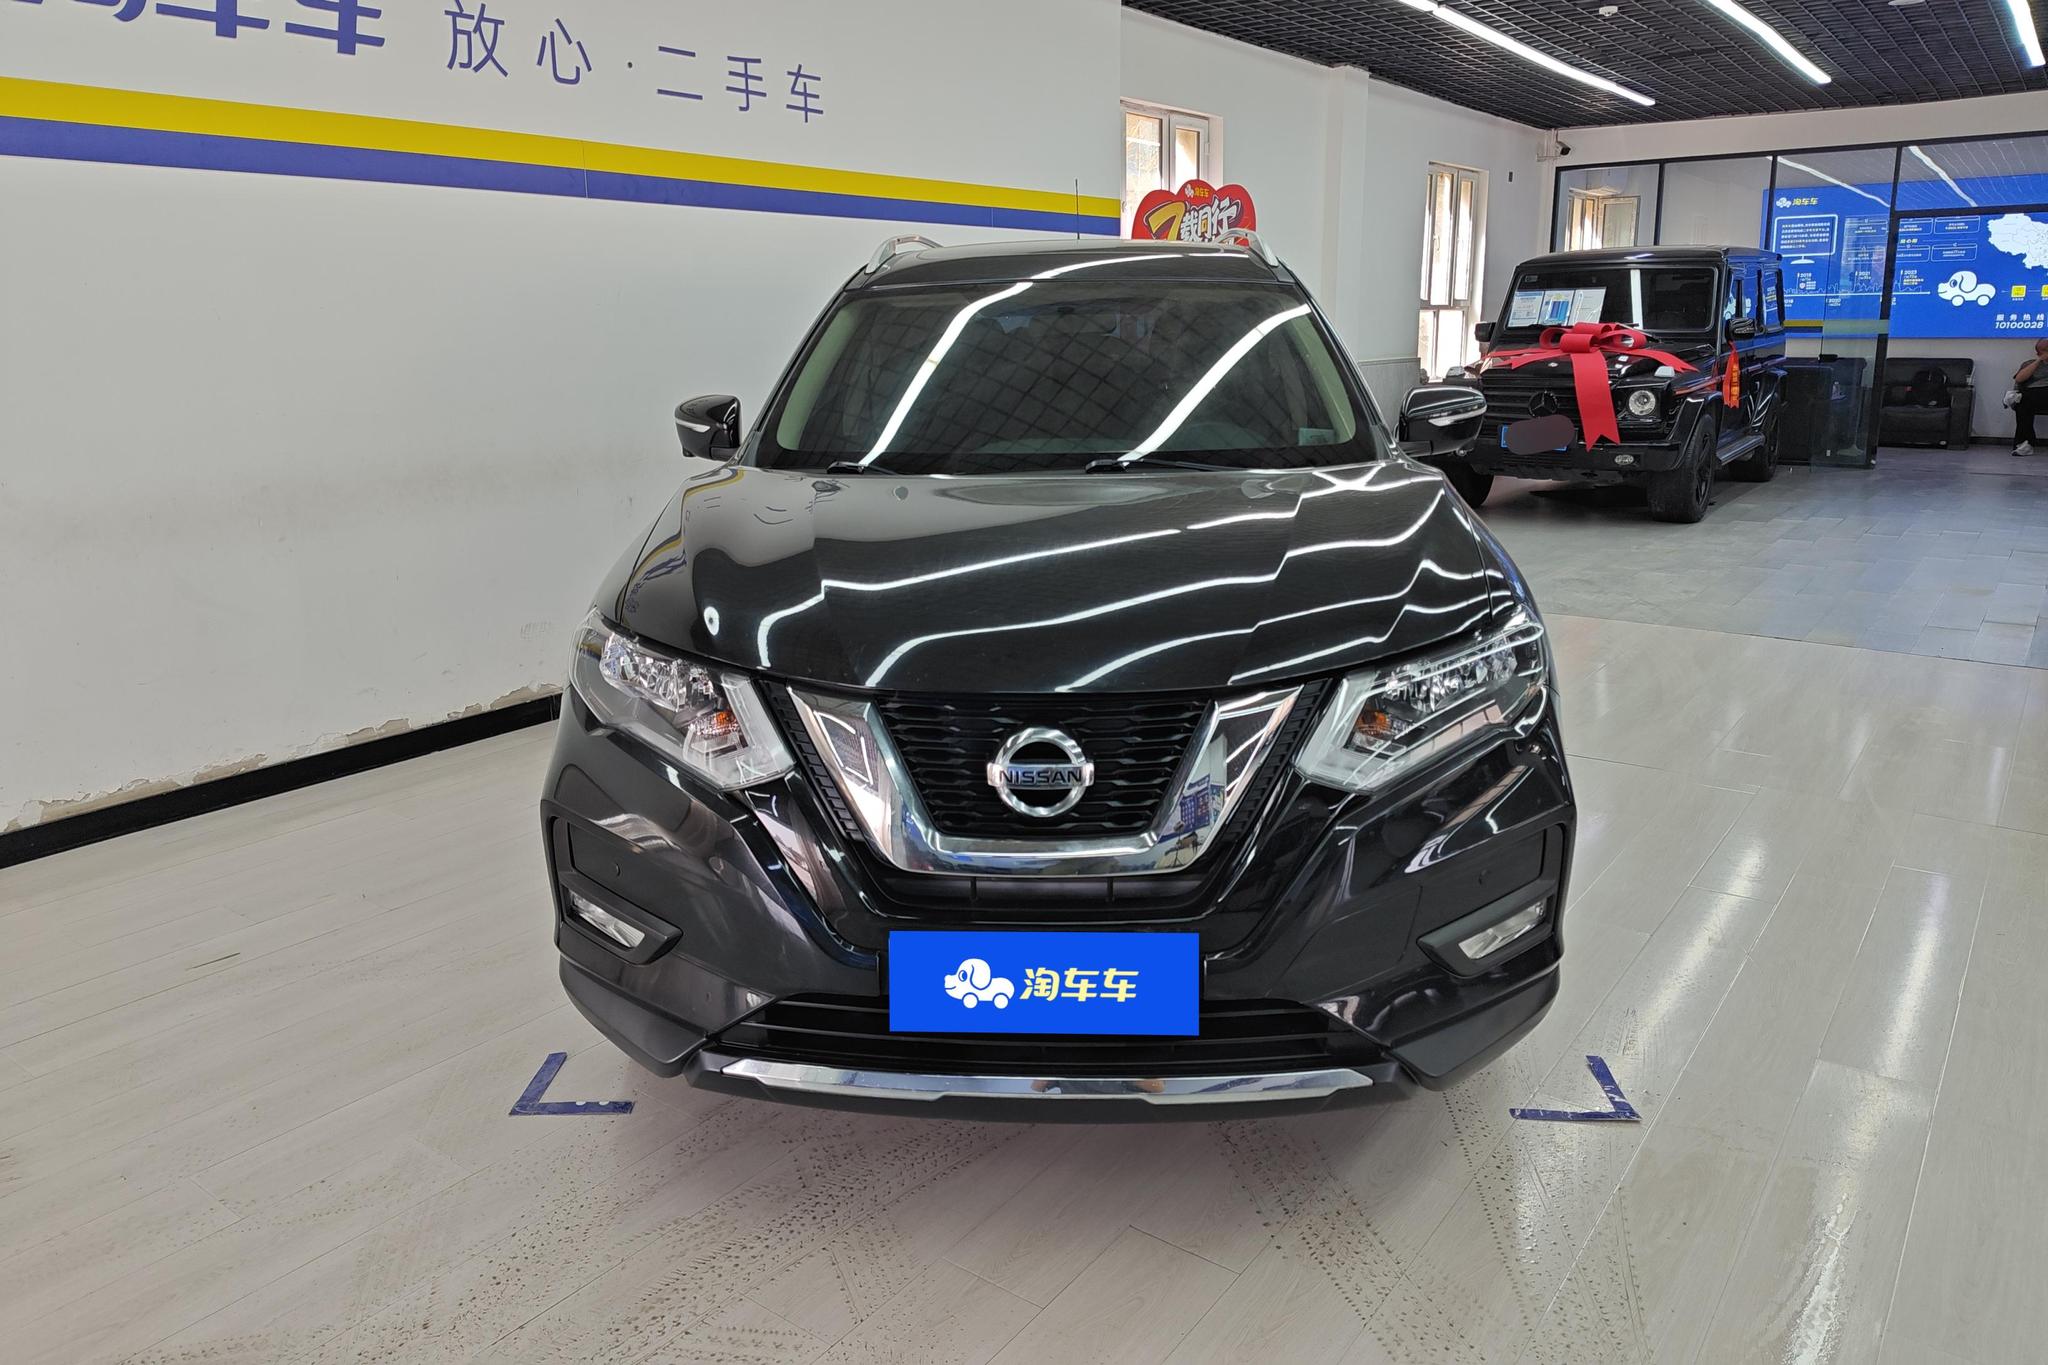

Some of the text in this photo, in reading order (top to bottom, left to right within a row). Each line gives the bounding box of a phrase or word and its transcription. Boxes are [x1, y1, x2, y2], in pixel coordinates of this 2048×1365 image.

[445, 1, 824, 124] 放心·二手车
[1995, 321, 2044, 329] 10100028
[999, 769, 1082, 784] NISSAN
